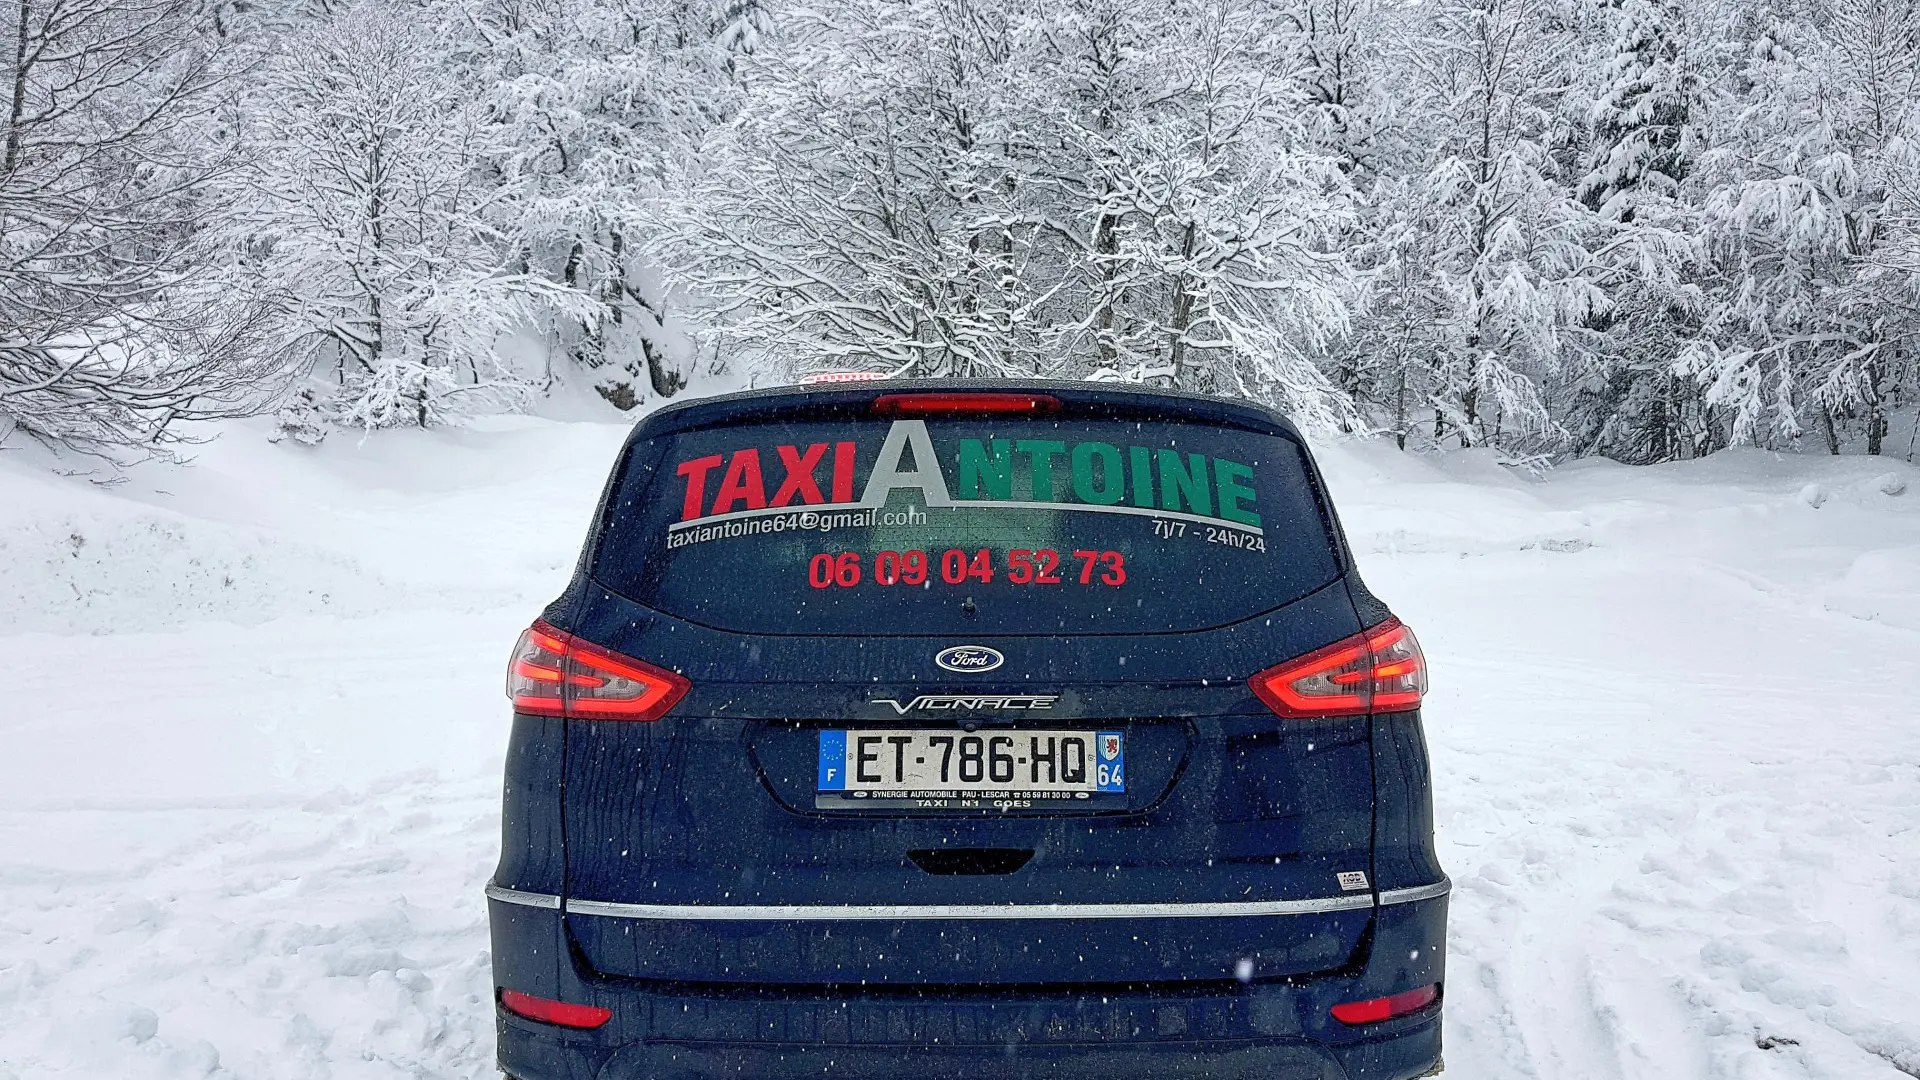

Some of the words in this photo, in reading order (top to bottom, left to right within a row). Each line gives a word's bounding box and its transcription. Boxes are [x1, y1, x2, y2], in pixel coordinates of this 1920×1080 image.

[677, 441, 856, 521] TAXI
[666, 508, 927, 549] taxiantoine64@gmail.com
[1152, 519, 1187, 539] 7j/7
[1206, 527, 1266, 553] 24h/24
[808, 551, 861, 589] 06
[874, 549, 928, 585] 09
[941, 548, 994, 584] 04
[1007, 549, 1060, 584] 52
[1073, 549, 1127, 586] 73
[950, 651, 988, 667] Ford
[857, 736, 1086, 784] ET-786-HQ
[827, 768, 837, 782] F
[1097, 763, 1123, 786] 64
[872, 790, 908, 798] SYNERGIE
[910, 790, 957, 798] AUTOMOBILE
[962, 790, 977, 798] PAU
[981, 791, 1010, 799] LESCAR
[1022, 791, 1031, 799] 05
[1032, 791, 1041, 799] 59
[1042, 791, 1050, 799] 81
[1052, 791, 1061, 799] 30
[1062, 791, 1071, 799] 00
[916, 799, 948, 807] TAXI
[993, 799, 1031, 807] GOES
